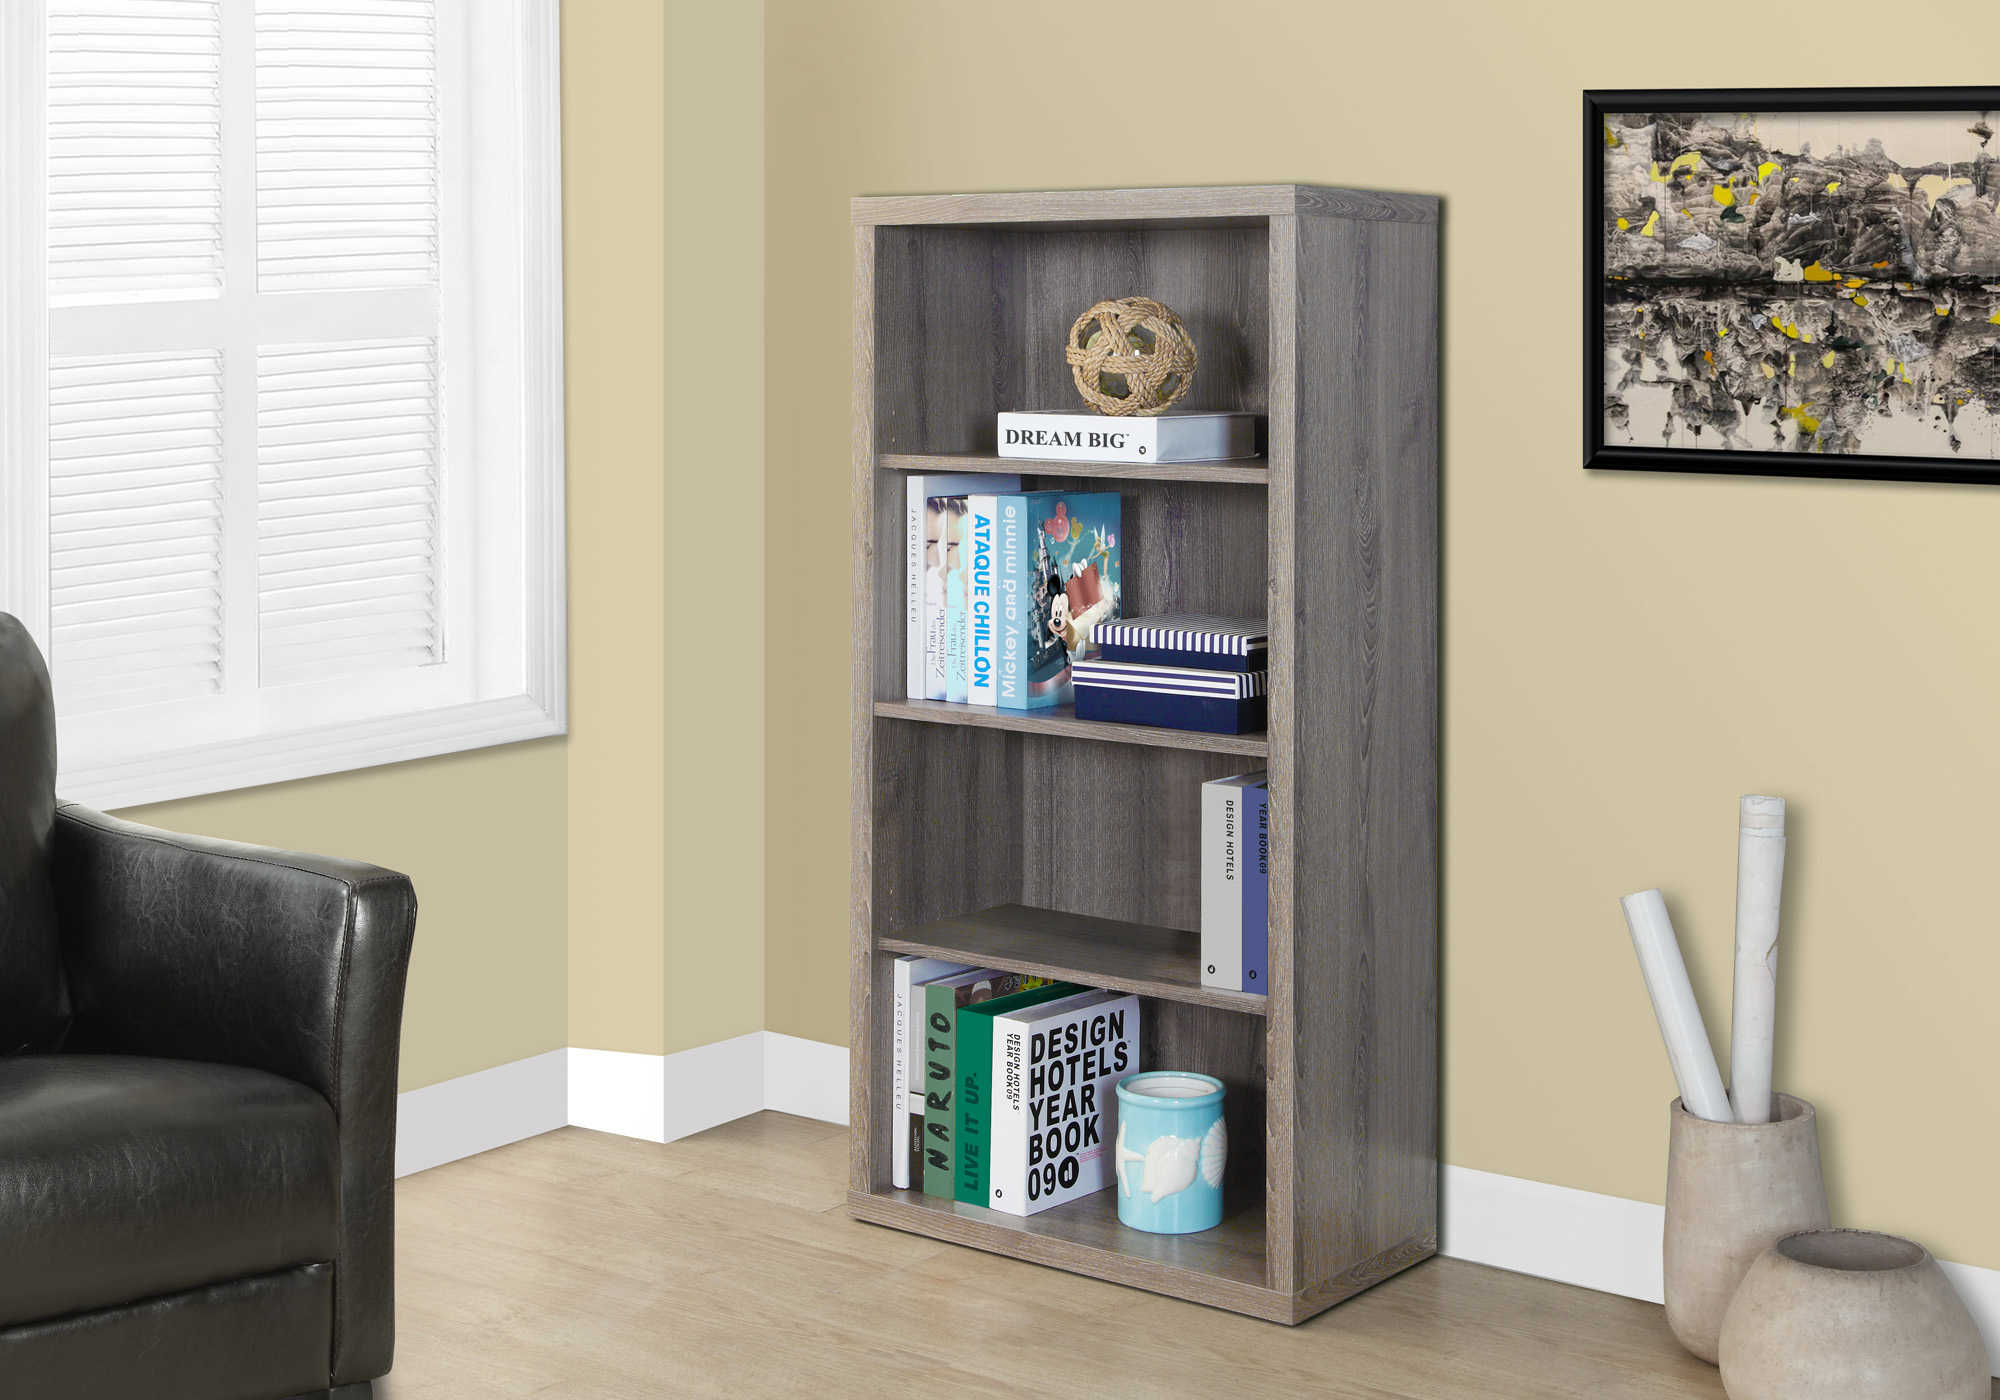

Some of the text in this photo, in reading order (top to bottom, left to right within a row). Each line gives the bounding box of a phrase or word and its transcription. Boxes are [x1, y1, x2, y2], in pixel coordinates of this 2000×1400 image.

[1005, 429, 1082, 447] DREAM
[974, 513, 991, 597] ATAQUE
[1001, 505, 1019, 698] Mickey and minnie
[1226, 800, 1234, 880] DESIGN HOTELS
[1259, 803, 1267, 829] YEAR
[1006, 1033, 1014, 1058] YEAR
[1030, 1009, 1125, 1066] DESIGN
[926, 1012, 953, 1172] NARUTO
[1030, 1041, 1129, 1099] HOTELS
[964, 1111, 979, 1135] IT
[1028, 1084, 1096, 1132] YEAR
[1029, 1114, 1100, 1166] BOOK
[964, 1142, 979, 1192] LIVE
[1027, 1163, 1056, 1202] 09
